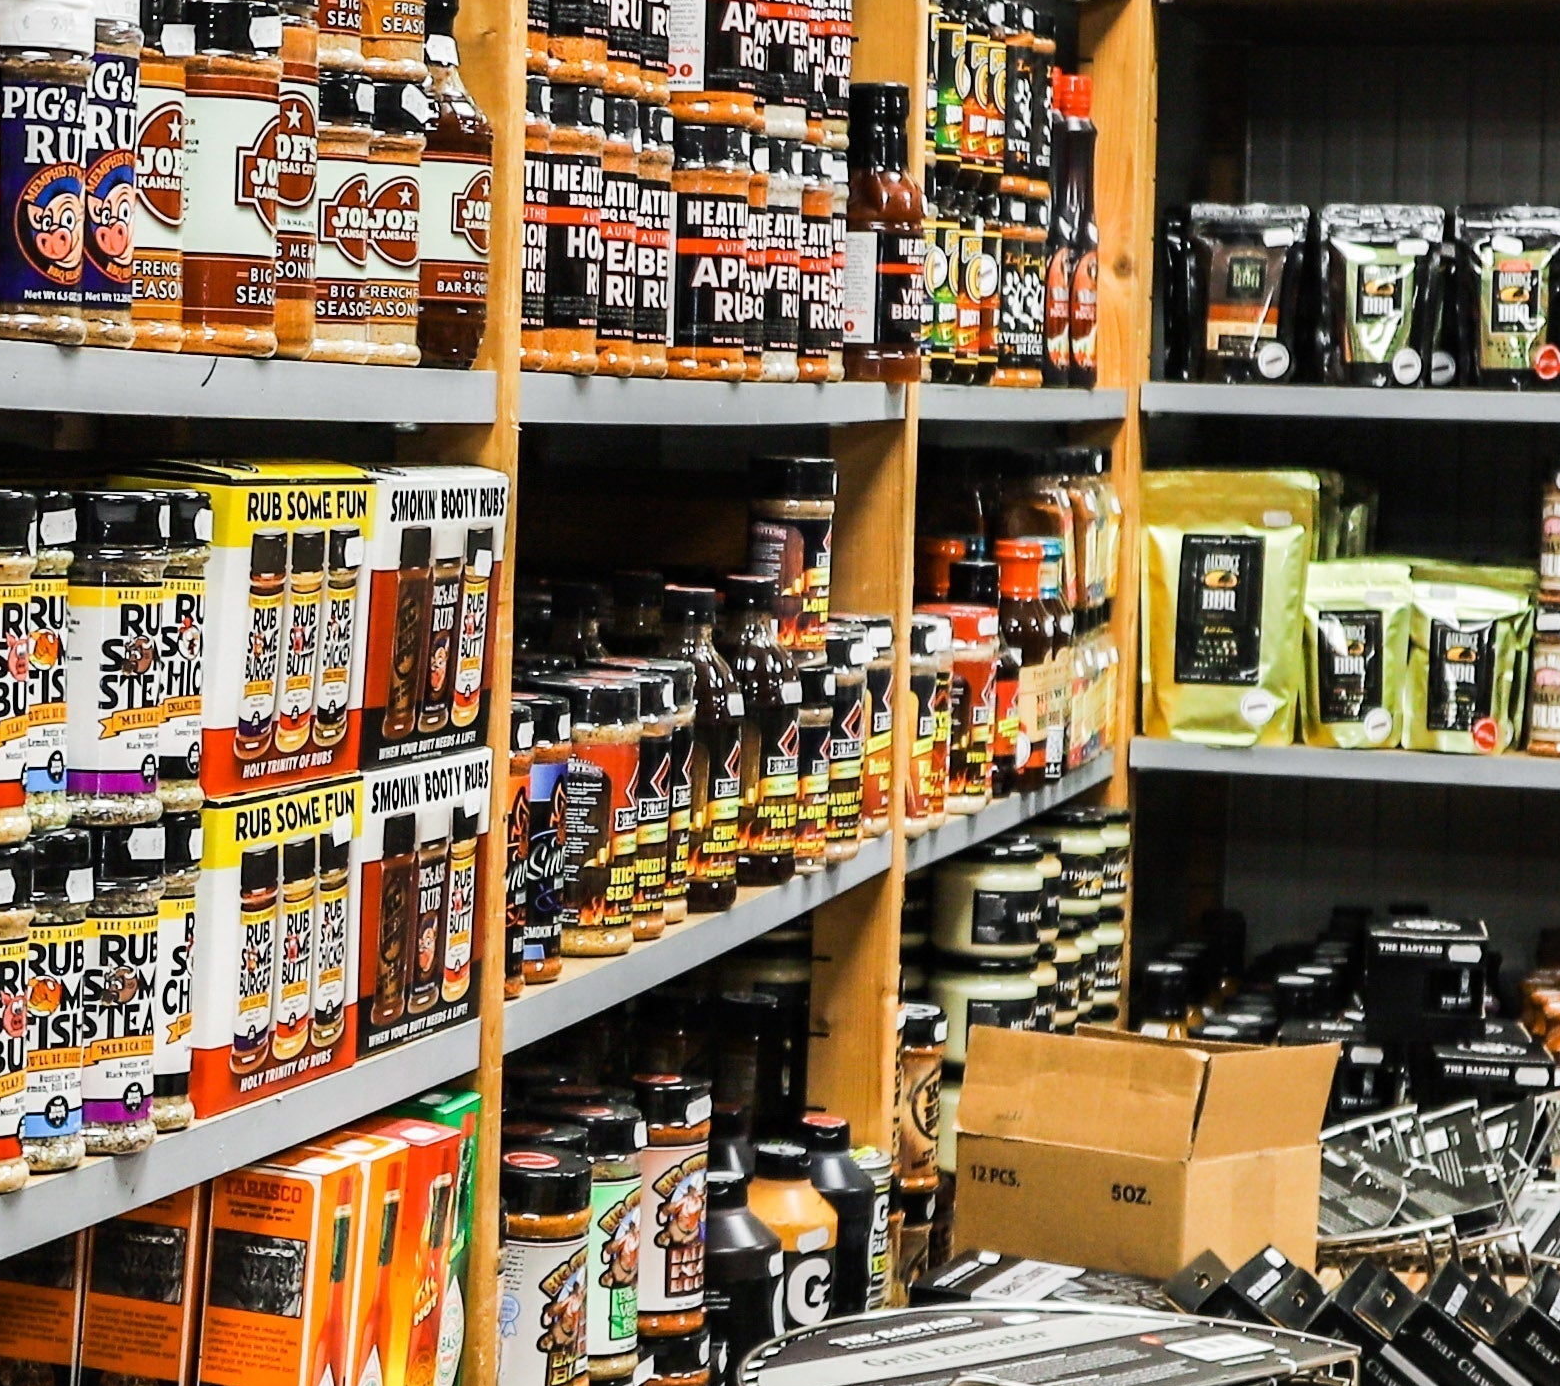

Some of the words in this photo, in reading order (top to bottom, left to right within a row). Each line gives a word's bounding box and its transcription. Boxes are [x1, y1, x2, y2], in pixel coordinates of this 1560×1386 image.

[2, 86, 76, 122] PIG's
[248, 491, 280, 522] RUB
[288, 491, 330, 520] SOME
[337, 491, 367, 518] FUN
[390, 490, 438, 522] SMOKIN'
[441, 489, 477, 519] BOOTY
[480, 487, 506, 517] RUBS
[293, 604, 316, 626] RUB
[432, 607, 454, 631] RUB
[286, 651, 313, 675] BUTT
[243, 762, 265, 779] HOLY
[266, 757, 297, 775] TRINITY
[298, 755, 310, 769] OF
[311, 751, 333, 768] RUBS
[372, 775, 420, 814] SMOKIN'
[426, 767, 463, 802] BOOTY
[465, 760, 489, 793] RUBS
[235, 809, 272, 841] RUB
[277, 799, 320, 833] SOME
[326, 789, 355, 822] FUN
[419, 887, 441, 911] RUB
[246, 924, 270, 946] RUB
[240, 1072, 263, 1093] HOLY
[265, 1061, 297, 1084] TRINITY
[298, 1056, 310, 1073] OF
[310, 1049, 333, 1069] RUBS
[1444, 1063, 1469, 1076] THE
[1471, 1064, 1510, 1077] BASTARD
[224, 1179, 303, 1203] TABASCO
[970, 1165, 988, 1182] 12
[991, 1166, 1021, 1188] PCS.
[414, 1295, 439, 1327] HOT
[931, 1328, 1052, 1362] Elevator
[1422, 1326, 1457, 1360] Bear
